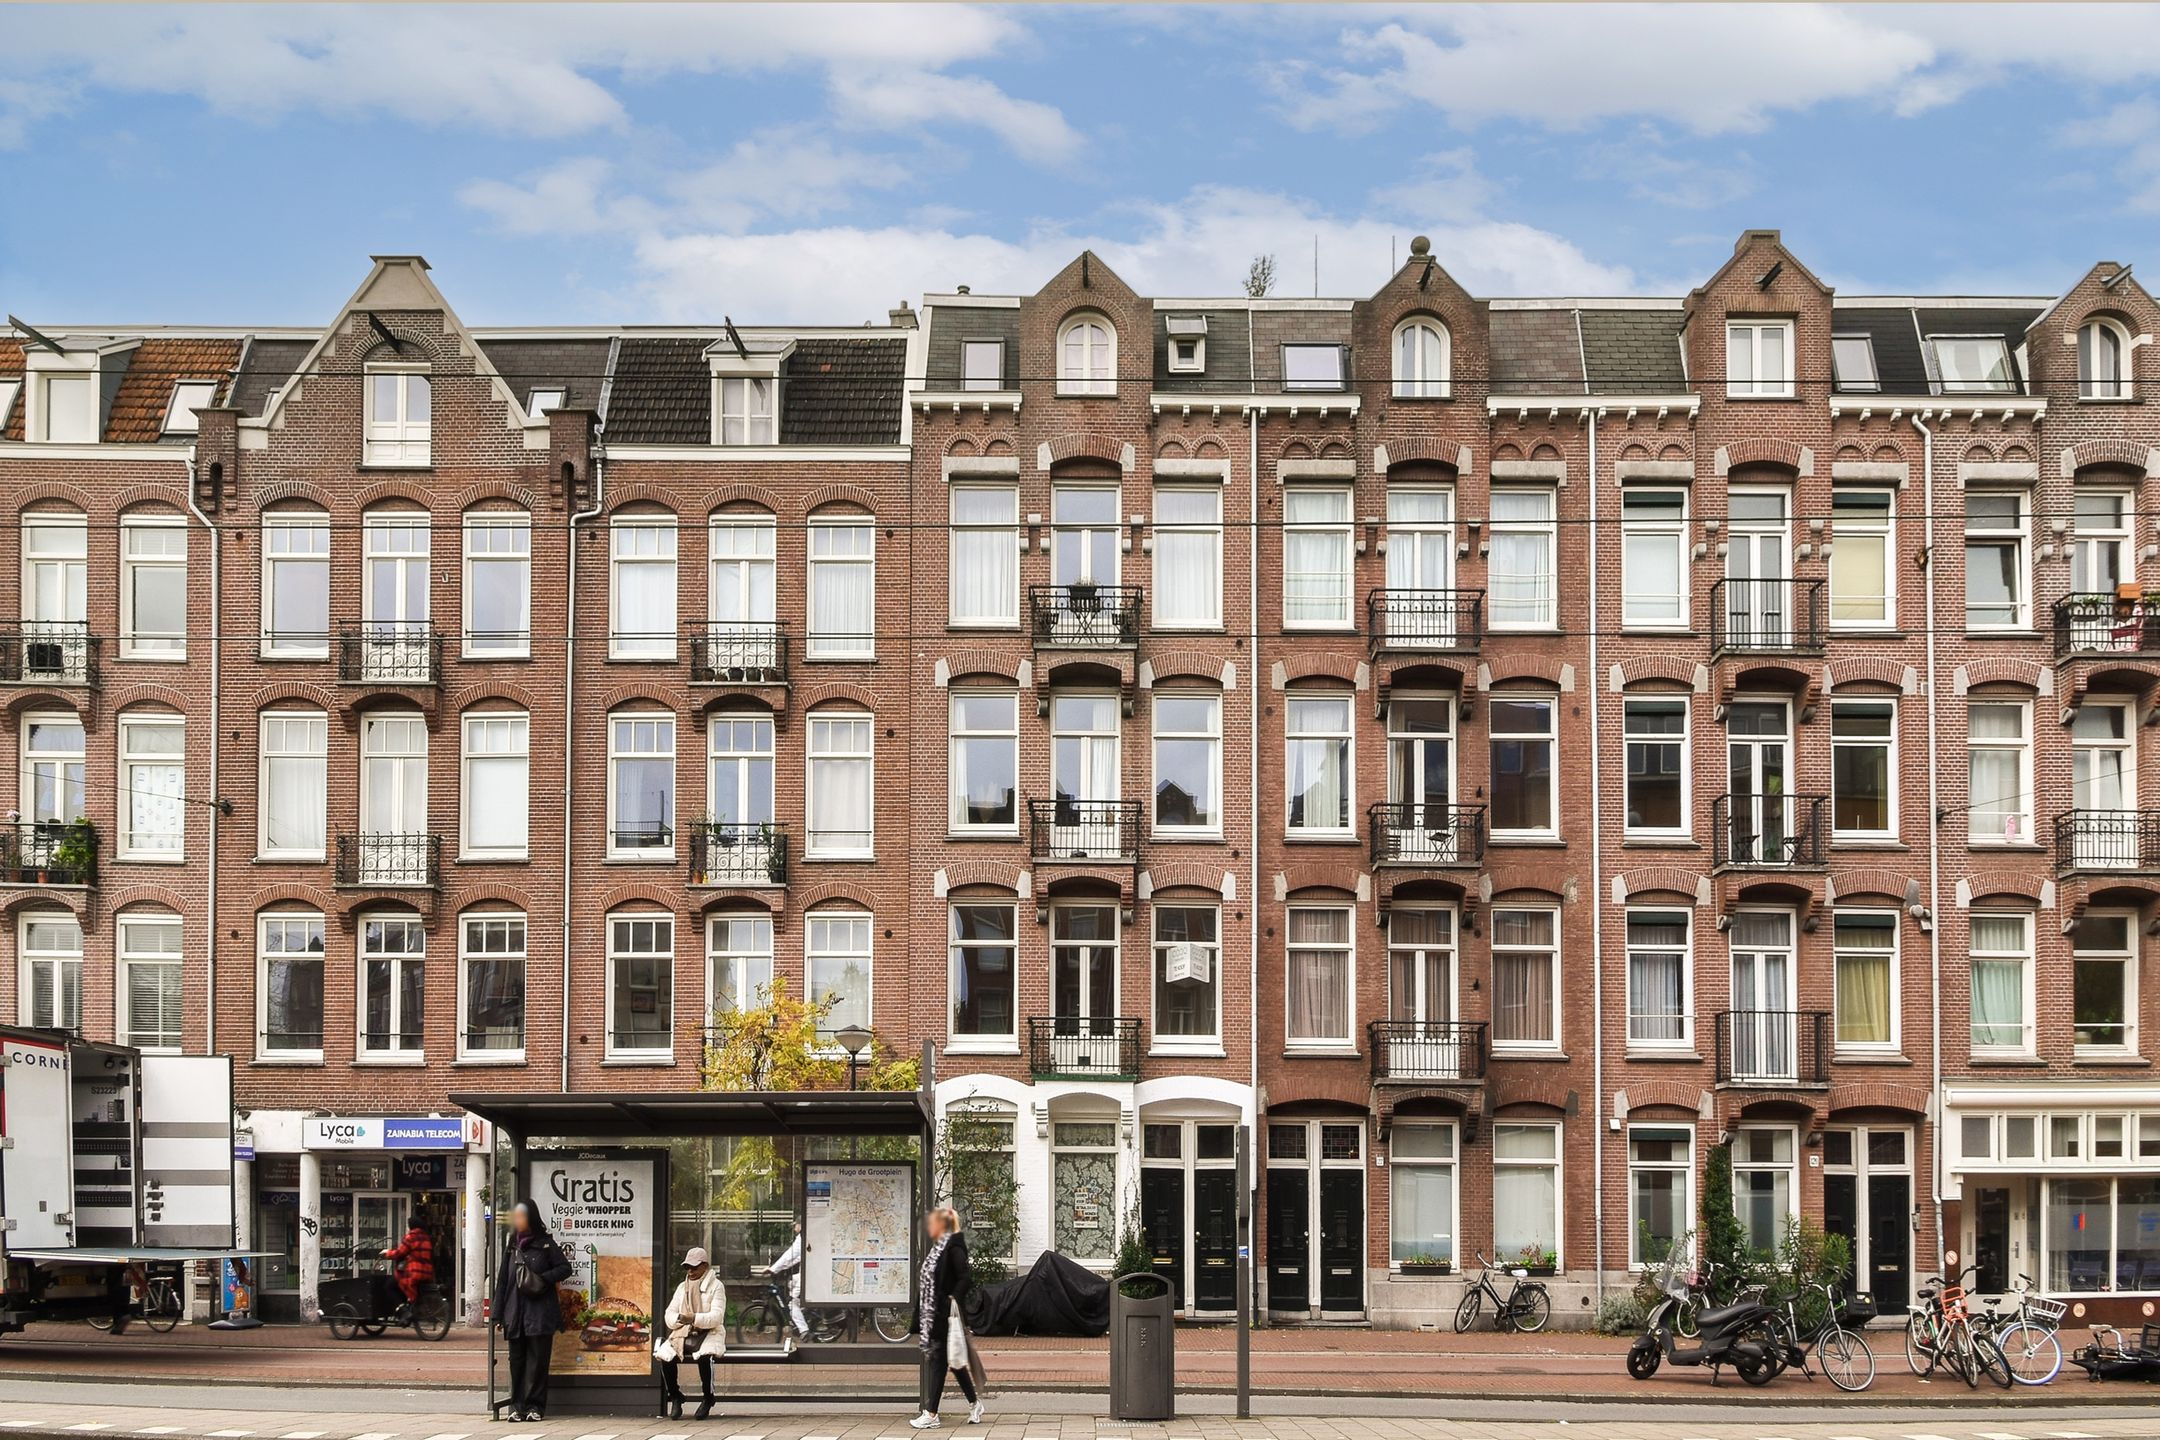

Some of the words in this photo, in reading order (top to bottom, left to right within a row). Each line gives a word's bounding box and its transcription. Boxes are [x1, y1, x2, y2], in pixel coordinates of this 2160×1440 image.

[320, 1122, 354, 1139] Lyca
[387, 1129, 424, 1138] ZAINABIA
[425, 1129, 461, 1138] TELECOM
[402, 1161, 431, 1177] Lyca
[839, 1168, 855, 1176] Hugo
[868, 1168, 902, 1176] Grootplein
[550, 1169, 634, 1203] Gratis
[552, 1203, 583, 1216] Veggie
[551, 1218, 562, 1231] bij
[574, 1220, 609, 1229] BURGER
[611, 1220, 634, 1229] KING
